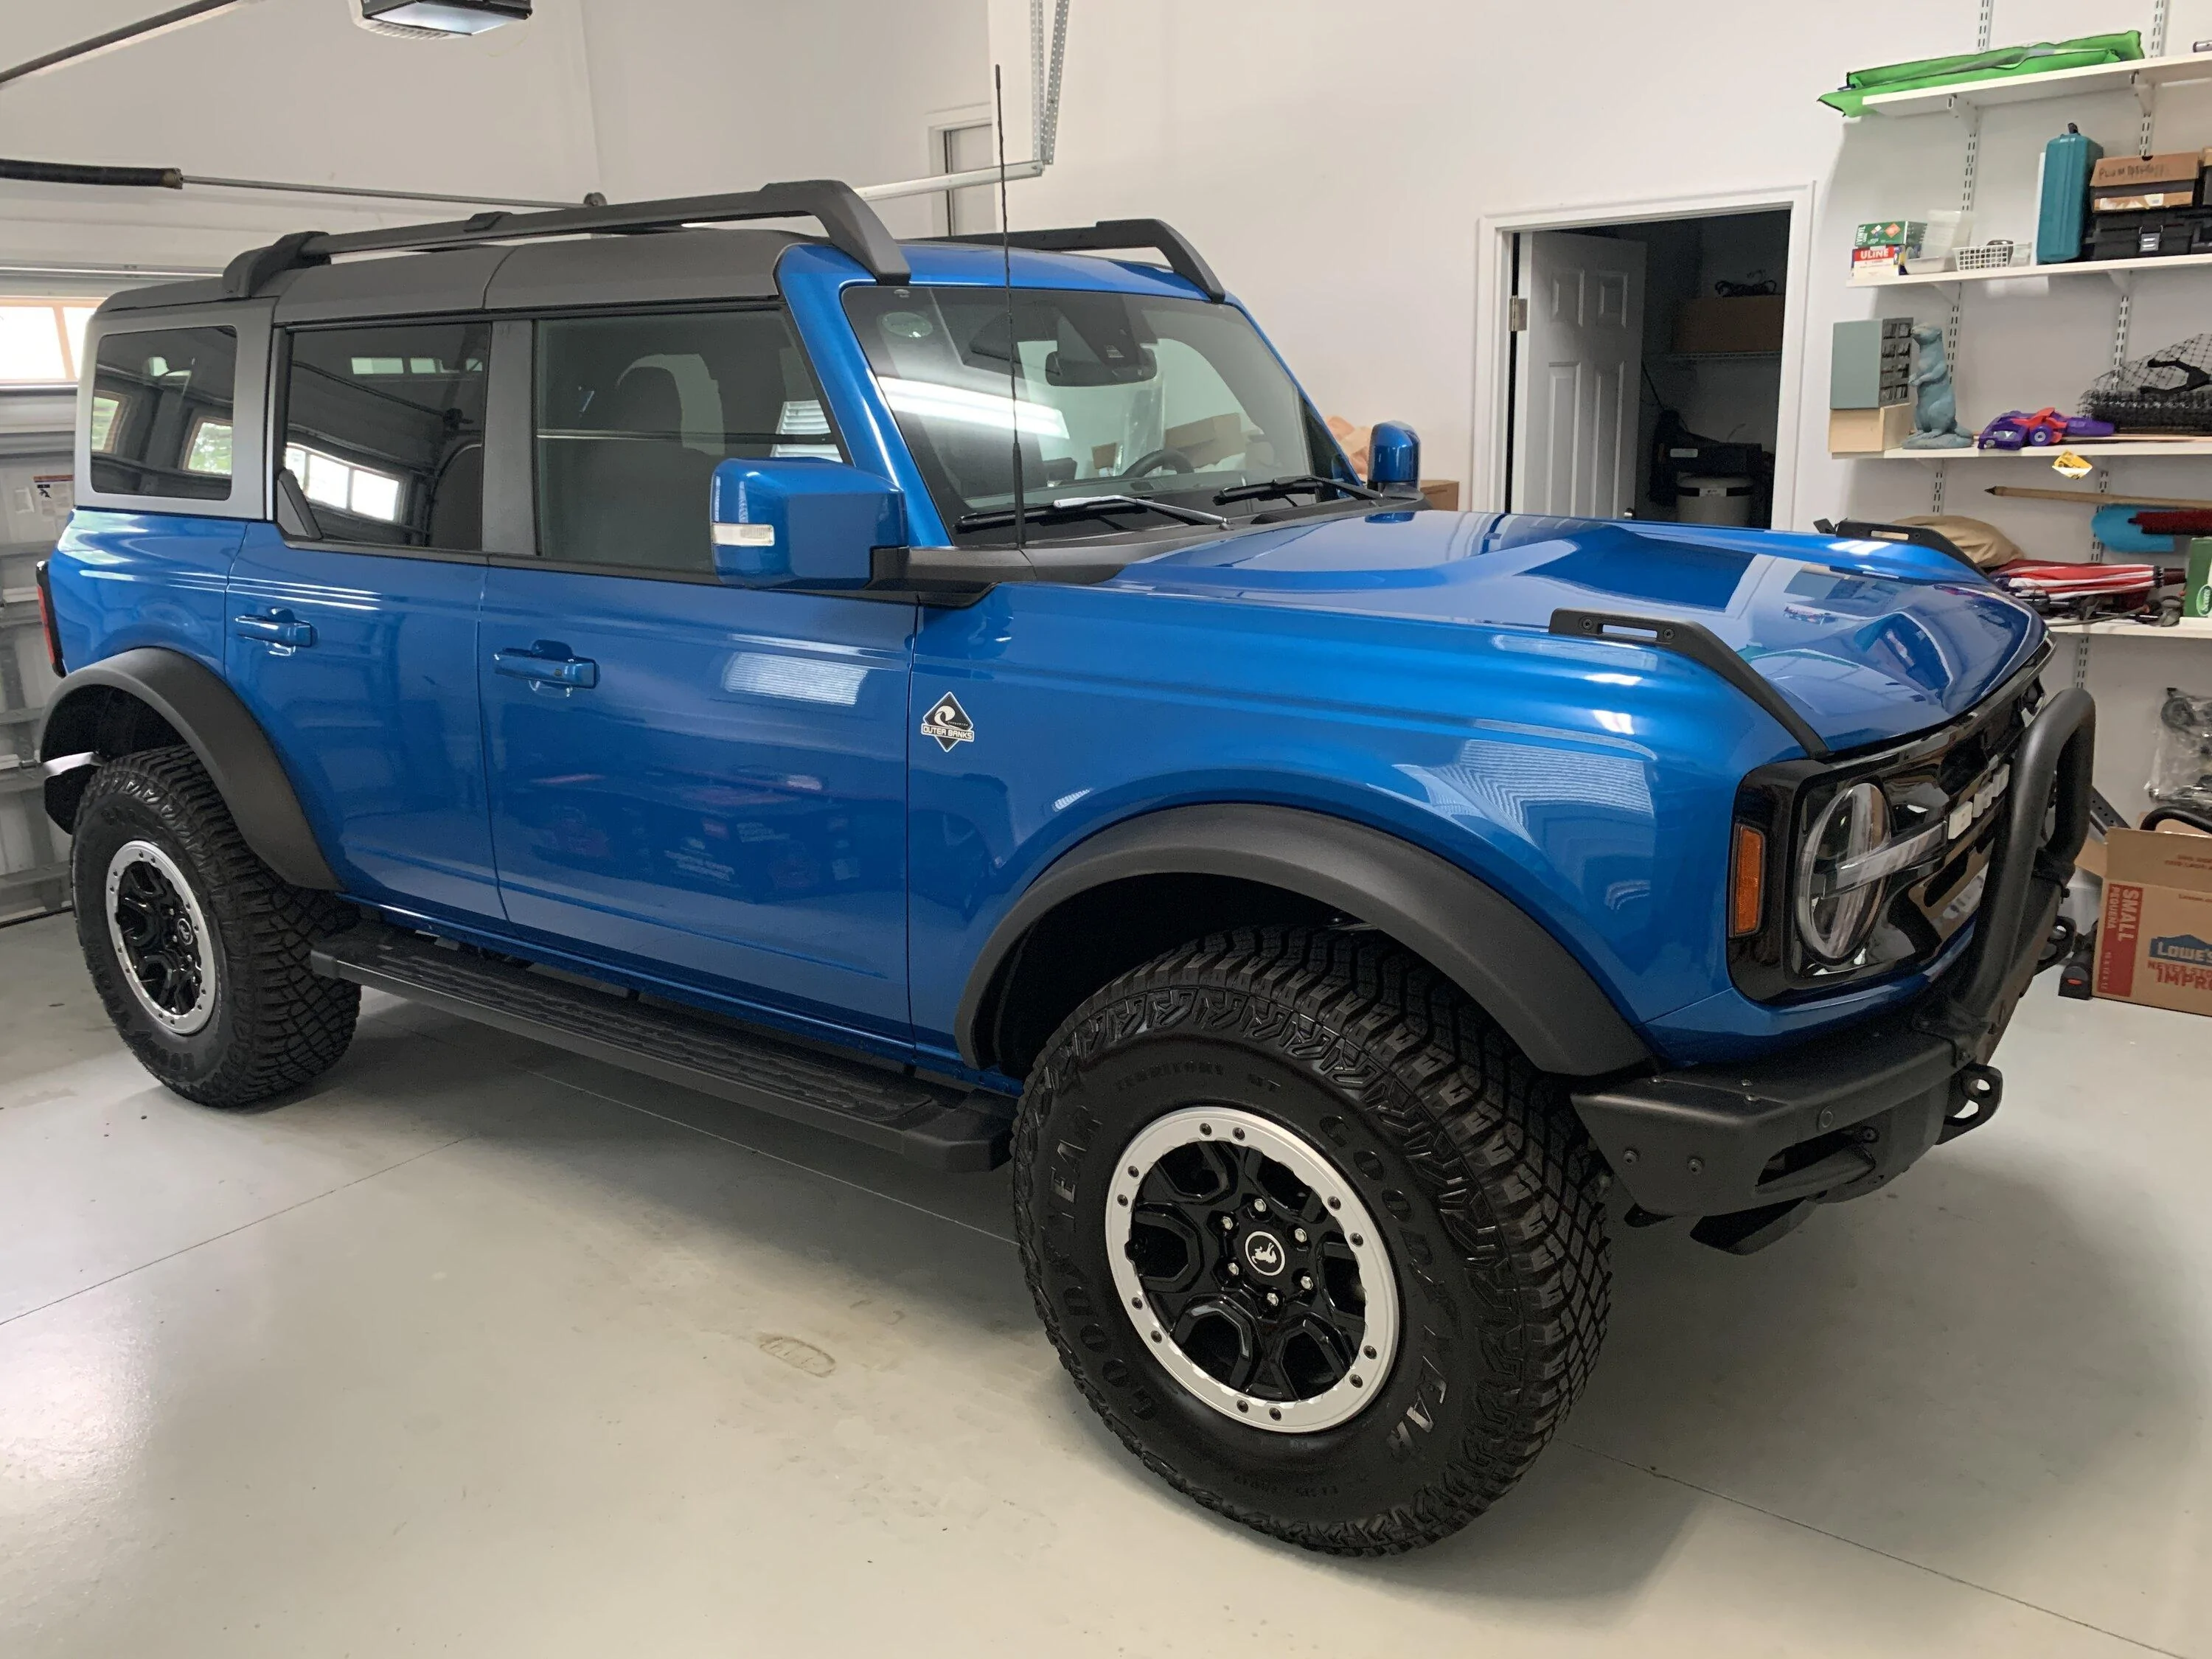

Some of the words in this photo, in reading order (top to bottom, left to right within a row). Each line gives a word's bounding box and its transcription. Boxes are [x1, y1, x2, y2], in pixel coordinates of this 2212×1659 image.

[1860, 248, 1889, 260] ULINE
[923, 726, 947, 736] OUTER
[947, 729, 973, 740] BANKS
[2118, 888, 2139, 942] SMALL
